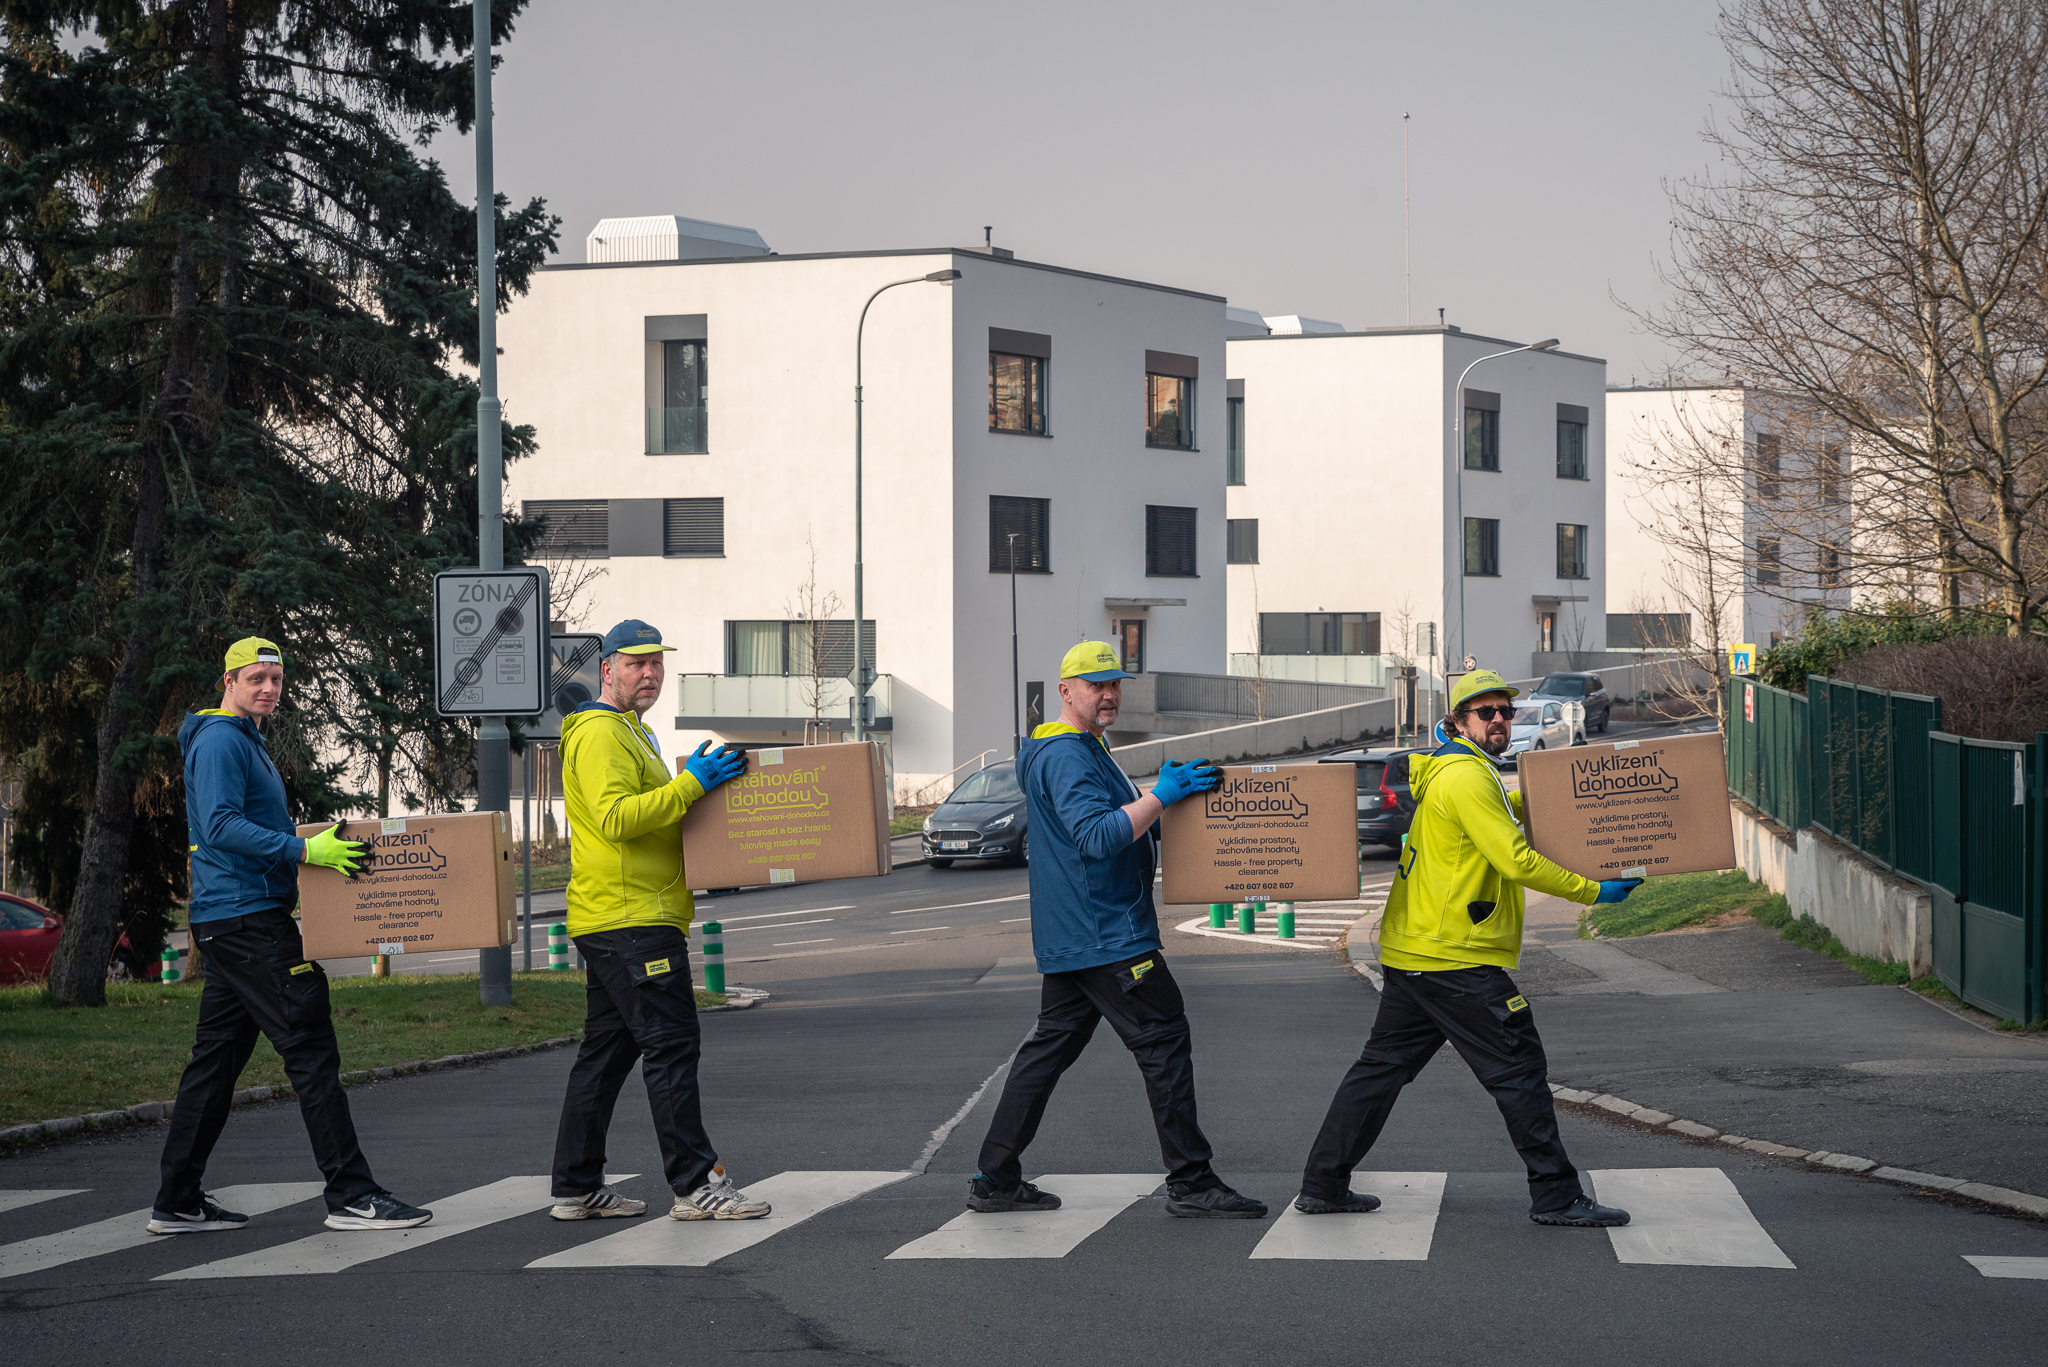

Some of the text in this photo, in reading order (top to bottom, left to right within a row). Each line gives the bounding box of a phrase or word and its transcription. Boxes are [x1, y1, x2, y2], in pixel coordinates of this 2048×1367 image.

[458, 579, 516, 603] ZÓNA
[1575, 751, 1658, 777] Vyklízení
[1215, 777, 1291, 798] yklízení
[1578, 771, 1662, 793] dohodou
[731, 787, 811, 807] dohodou
[1575, 794, 1680, 810] www.vyklizeni-dohodou.cz
[1210, 796, 1293, 813] dohodou
[727, 810, 830, 824] www.stehovani-dohodou.cz
[1631, 811, 1669, 821] prostory,
[728, 830, 744, 839] Bez
[787, 825, 803, 834] bez
[804, 822, 832, 832] hranic
[1205, 820, 1309, 831] www.vyklizeni-dohodou.cz
[1588, 820, 1673, 834] zachováme hodnoty
[740, 837, 822, 850] Moving made easy
[1259, 836, 1297, 846] prostory,
[1586, 837, 1615, 847] Hassle
[1622, 835, 1639, 844] free
[1640, 831, 1677, 843] property
[1216, 845, 1300, 855] zachováme hodnoty
[1611, 843, 1653, 854] clearance
[357, 849, 431, 867] ohodou
[747, 856, 768, 864] +420
[1213, 859, 1242, 867] Hassle
[1249, 858, 1266, 866] free
[1267, 858, 1303, 867] property
[1599, 861, 1620, 870] +420
[1637, 858, 1653, 866] 602
[1654, 856, 1669, 865] 607
[1238, 868, 1279, 876] clearance
[344, 872, 448, 886] www.vyklizeni-dohodou.cz
[1224, 883, 1245, 891] +420
[1262, 882, 1278, 890] 602
[399, 888, 436, 899] prostory,
[355, 897, 440, 910] zachováme hodnoty
[353, 913, 382, 922] Hassle
[389, 911, 406, 920] free
[407, 909, 443, 920] property
[378, 920, 419, 930] clearance
[364, 937, 386, 945] +420
[387, 936, 402, 944] 607
[419, 933, 435, 941] 607
